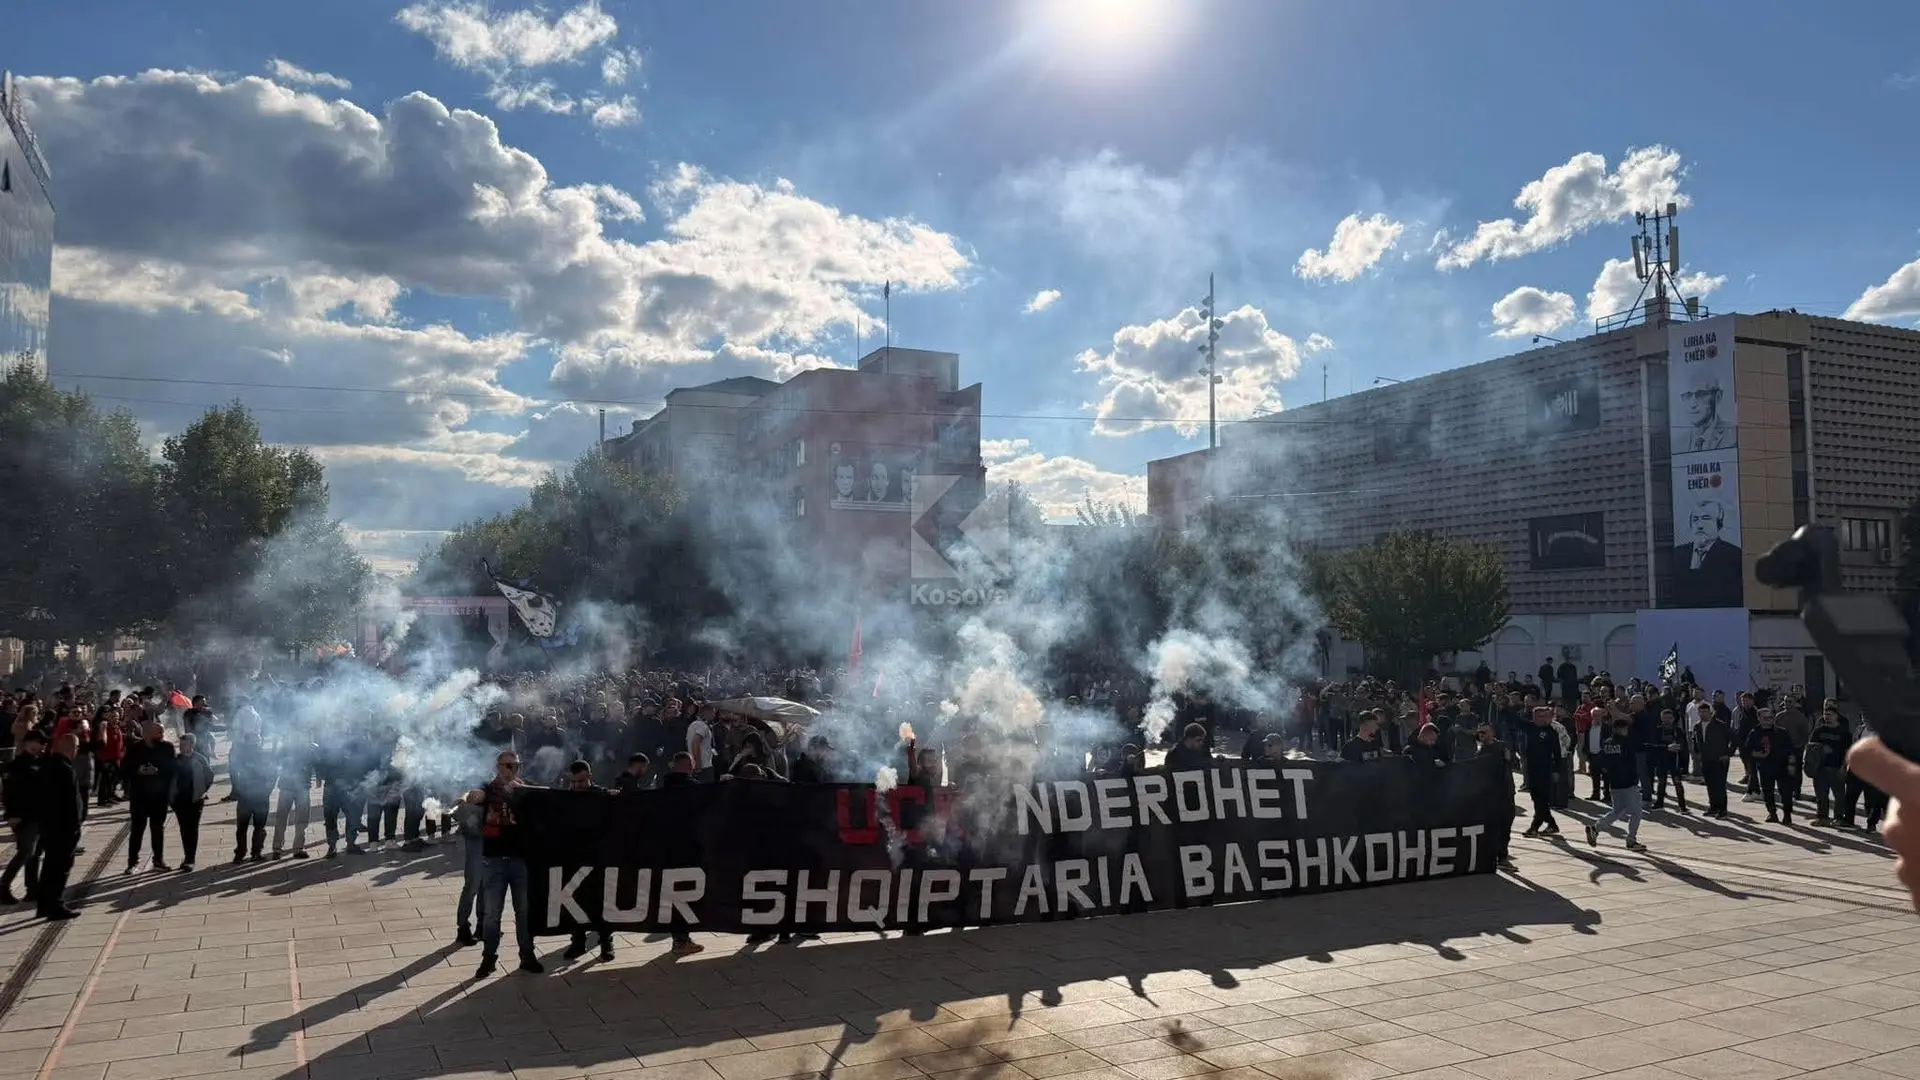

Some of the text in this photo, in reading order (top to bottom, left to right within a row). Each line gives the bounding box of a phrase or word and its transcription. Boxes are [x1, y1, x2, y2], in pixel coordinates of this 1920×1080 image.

[1710, 461, 1721, 473] KA
[1014, 768, 1313, 836] NDEROHET
[547, 825, 1485, 929] KUR SHQIPTARIA BASHKOHET
